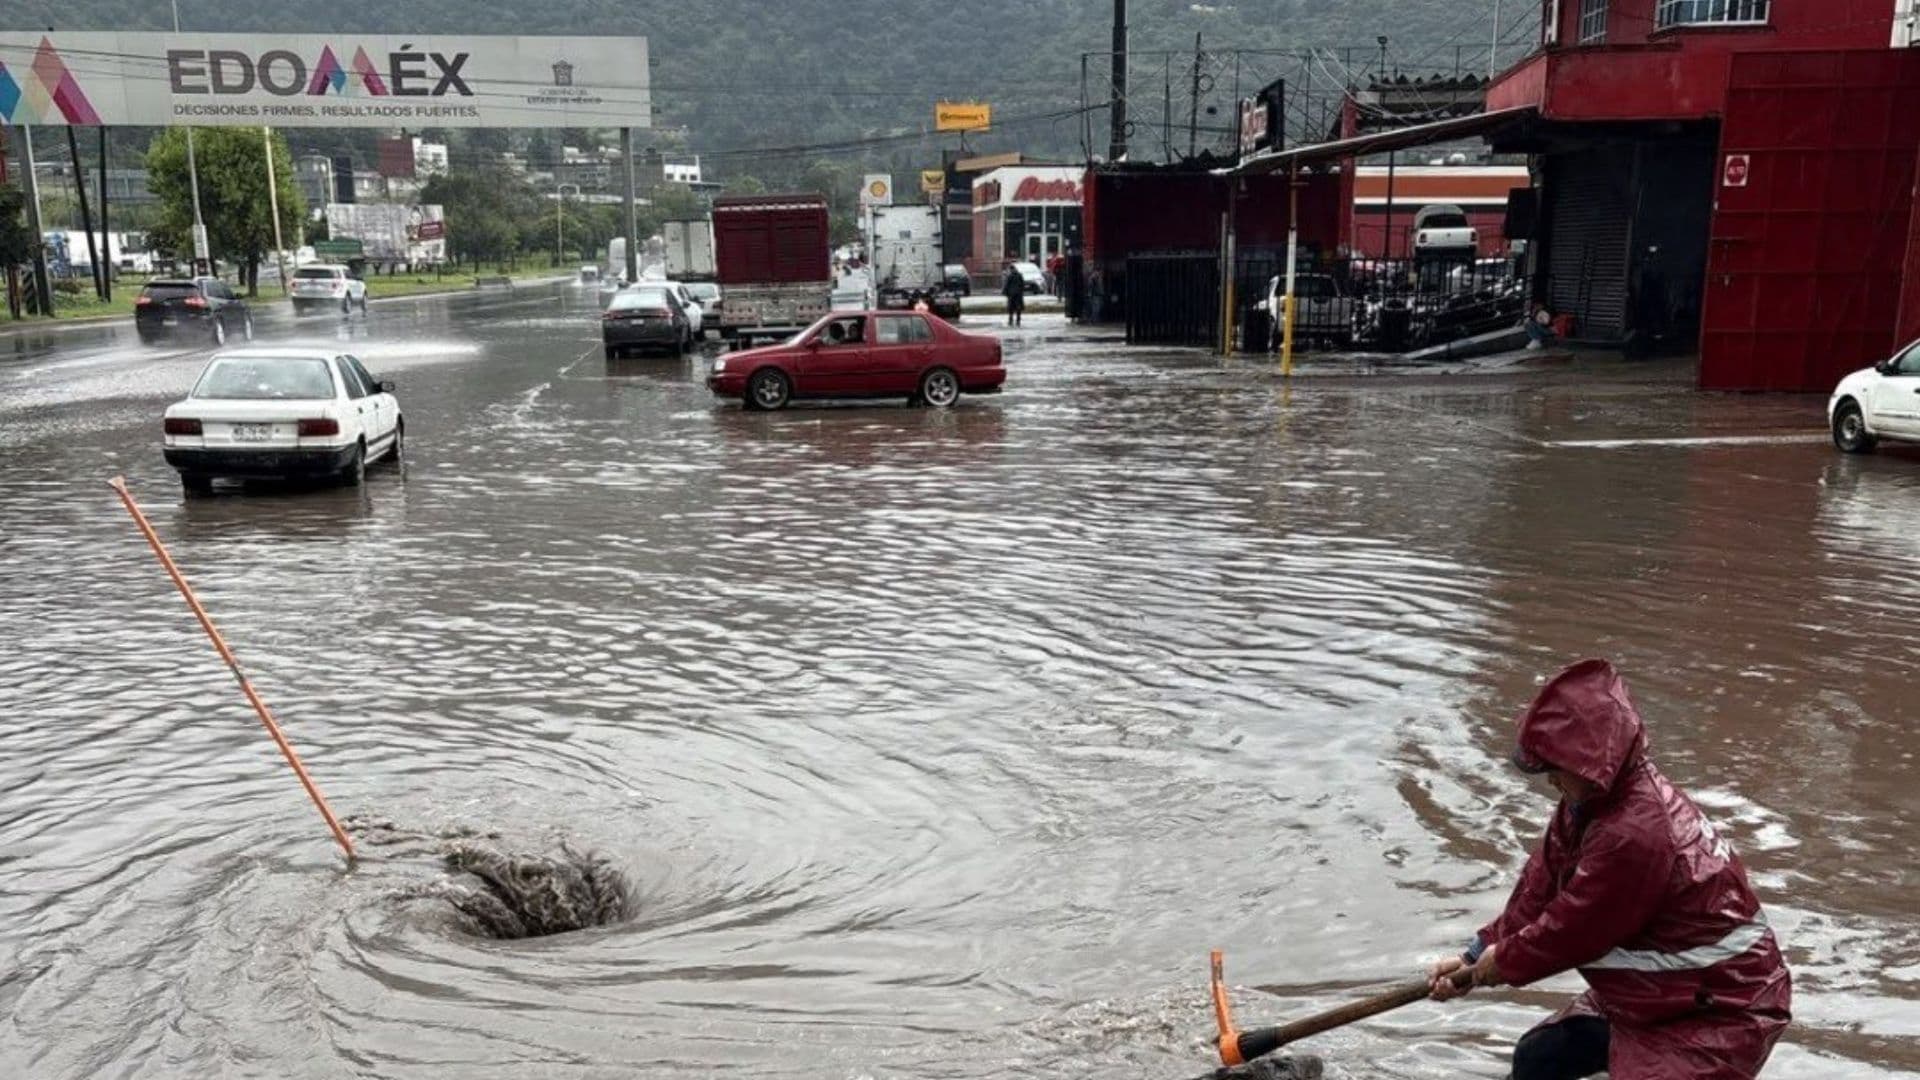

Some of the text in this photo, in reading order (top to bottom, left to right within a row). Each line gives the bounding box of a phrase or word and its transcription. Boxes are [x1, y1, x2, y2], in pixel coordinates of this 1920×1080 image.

[167, 43, 474, 97] EDOMÉX
[174, 104, 480, 117] DECISIONES FIRMES. RESULTADOS FUERTES.
